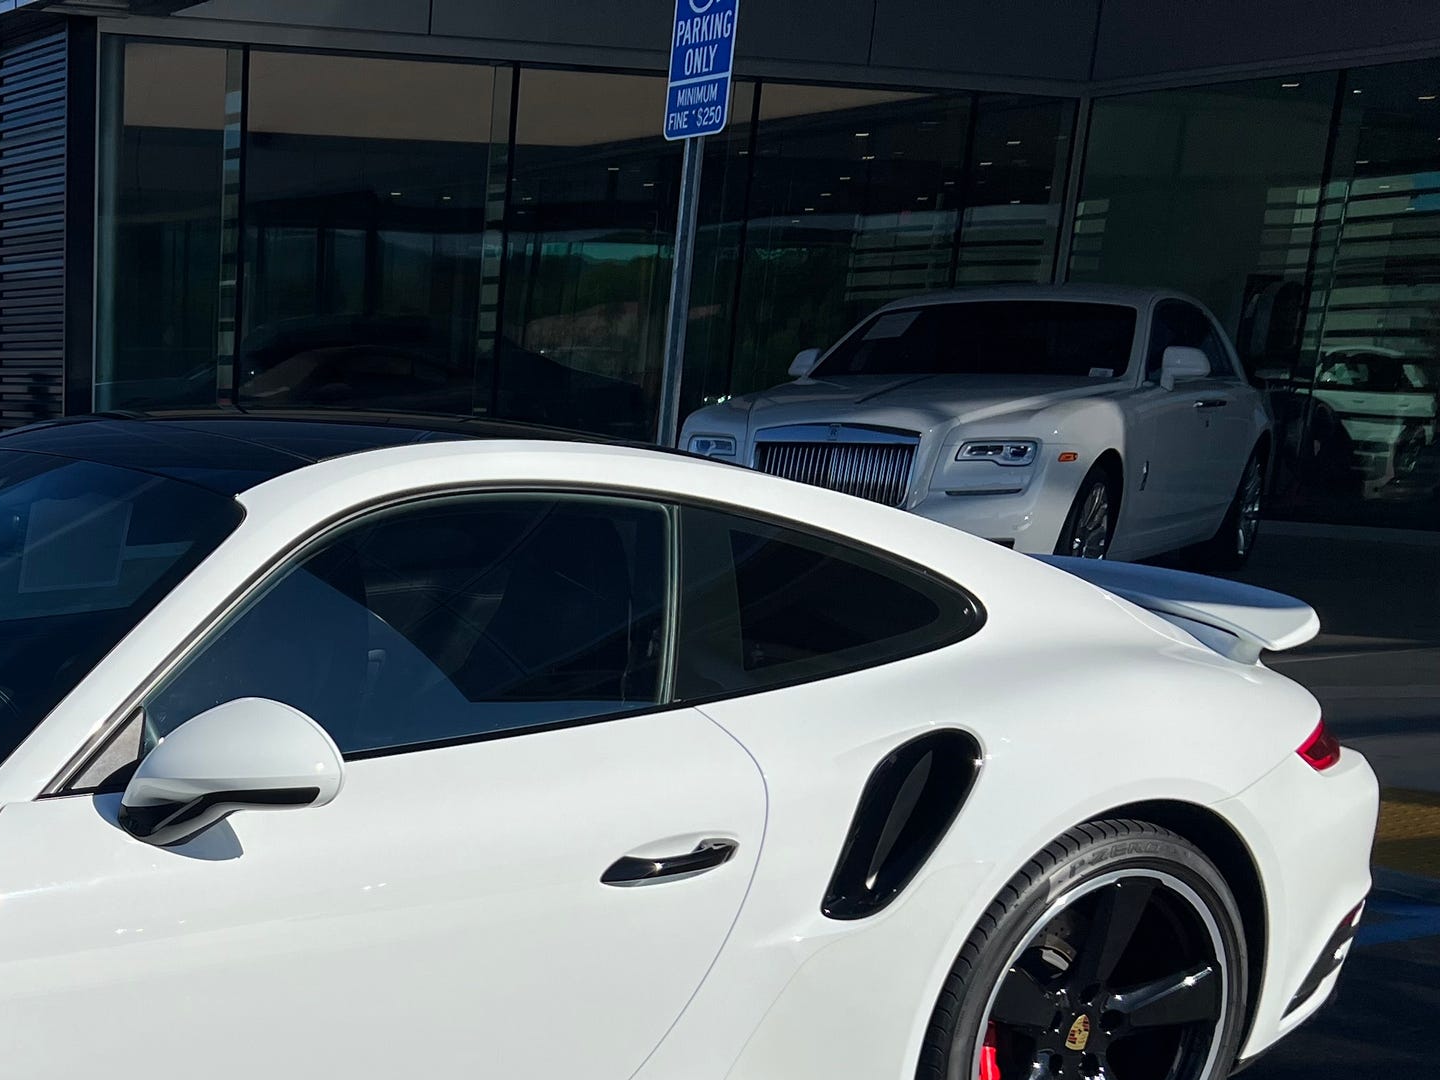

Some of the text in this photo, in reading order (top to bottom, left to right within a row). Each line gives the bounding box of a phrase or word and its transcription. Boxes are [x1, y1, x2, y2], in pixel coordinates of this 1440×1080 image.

[676, 9, 733, 48] PARKING
[684, 43, 719, 76] ONLY
[676, 82, 719, 108] MINIMUM
[667, 104, 722, 131] FINE $250
